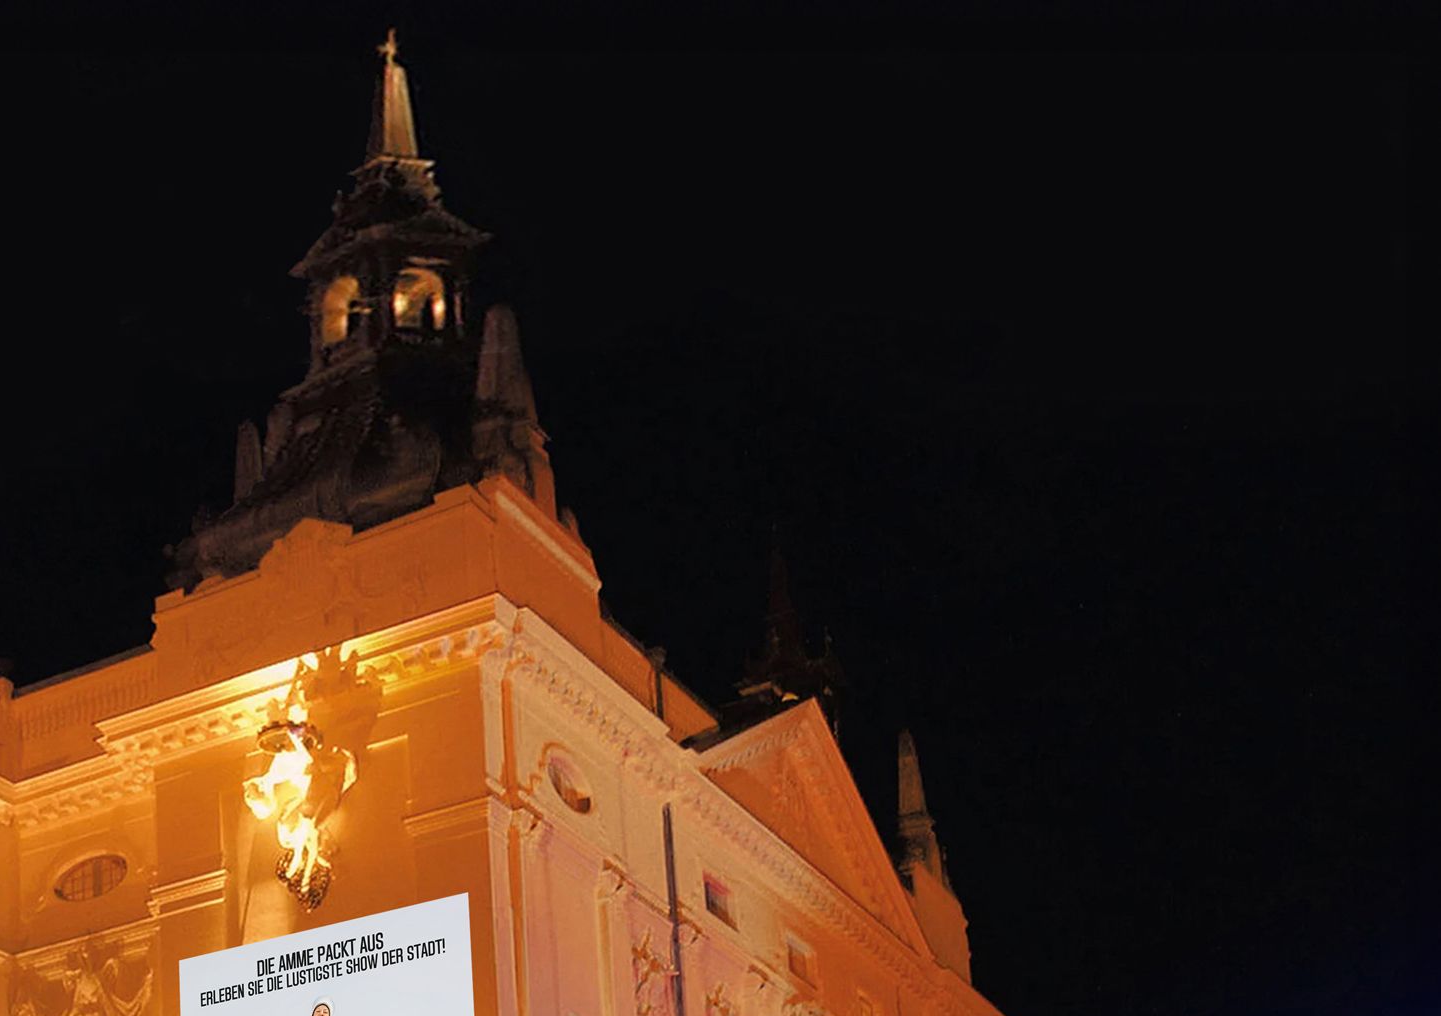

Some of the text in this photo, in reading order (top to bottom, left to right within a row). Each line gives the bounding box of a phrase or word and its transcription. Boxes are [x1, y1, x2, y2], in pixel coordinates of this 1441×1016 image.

[200, 938, 445, 1007] ERLEBEN SIE DIE LUSTIGSTE SHOW DER STADT!
[257, 932, 384, 977] DIE AMME PACKT AUS
